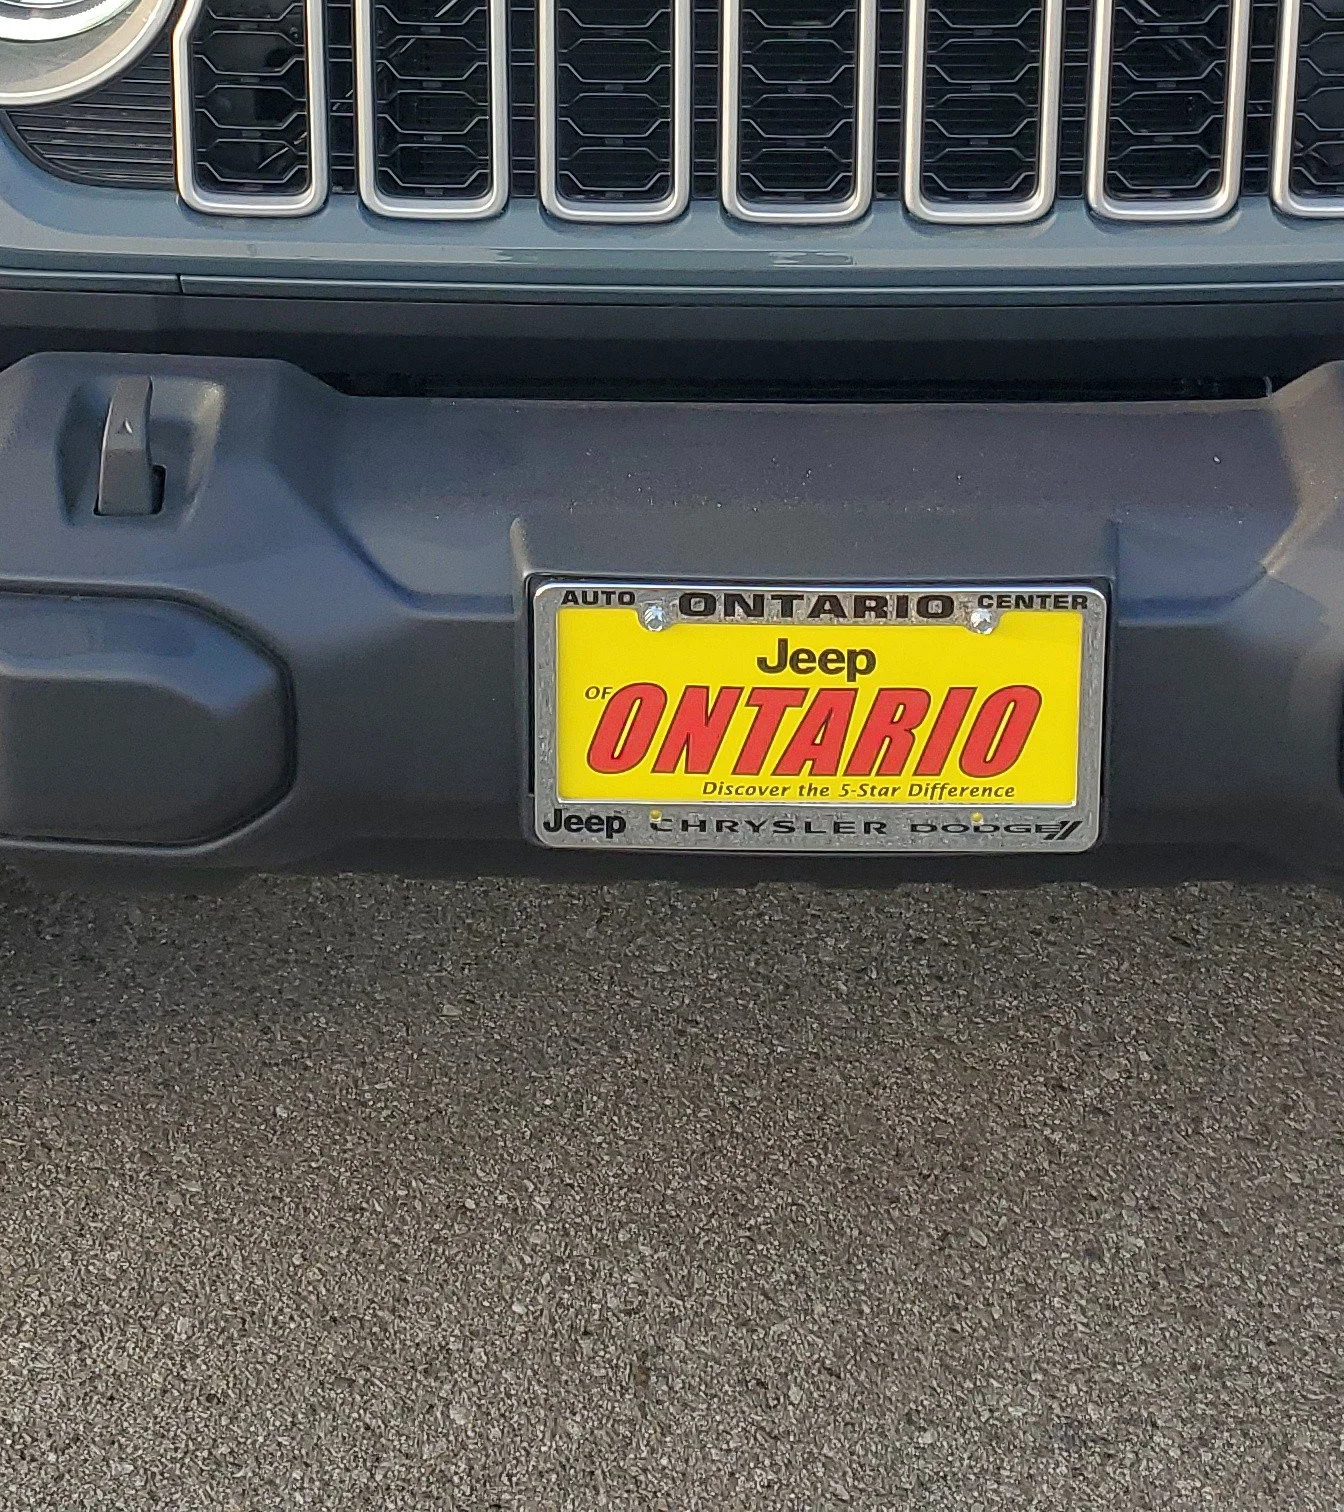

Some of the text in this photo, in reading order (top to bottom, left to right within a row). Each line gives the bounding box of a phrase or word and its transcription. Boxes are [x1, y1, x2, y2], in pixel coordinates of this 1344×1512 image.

[561, 590, 1088, 619] AUTO ONTARIO CENTER
[756, 638, 877, 682] Jeep
[585, 682, 1043, 779] OF ONTARIO
[702, 780, 1016, 799] Discover the 5-Star Difference
[543, 809, 1061, 838] Jeep CHRYSLER DODGE
